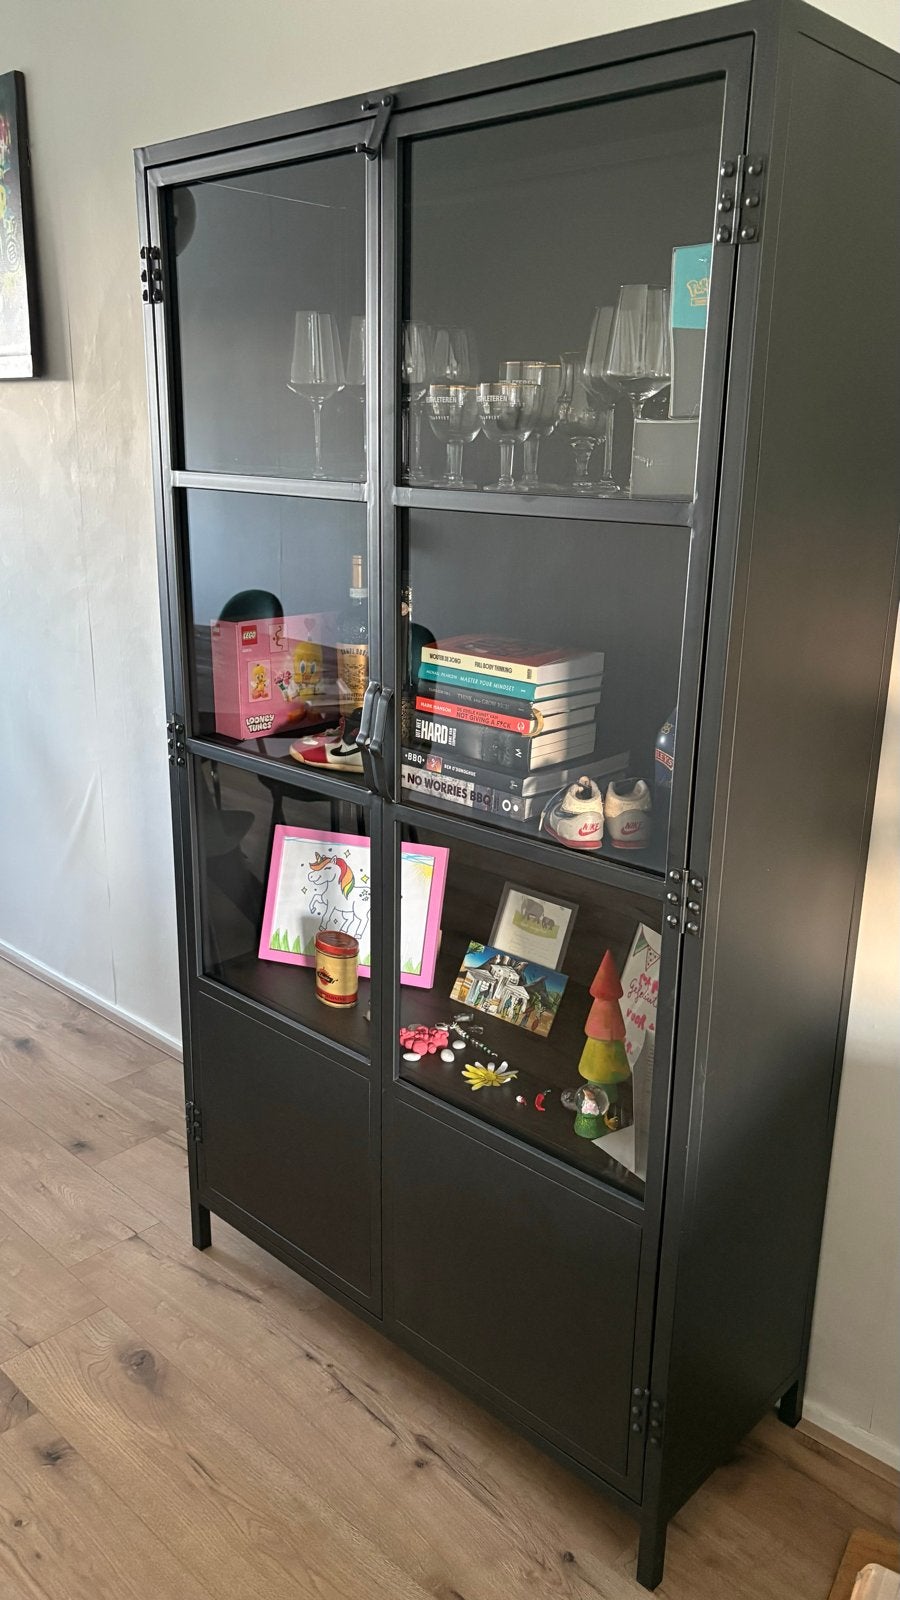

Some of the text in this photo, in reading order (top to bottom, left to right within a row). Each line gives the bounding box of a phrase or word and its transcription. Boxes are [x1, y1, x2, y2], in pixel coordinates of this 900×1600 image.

[243, 631, 257, 640] LEGO
[460, 676, 515, 692] MASTER YOUR MINDSET
[433, 704, 452, 713] MANSON
[246, 714, 275, 726] LOONEY
[456, 711, 469, 720] NOT
[469, 713, 490, 724] GIVING
[248, 721, 273, 733] TUNES
[420, 719, 449, 745] HARD
[407, 772, 491, 805] NO WORRIES BBQ
[582, 822, 600, 831] NIKE
